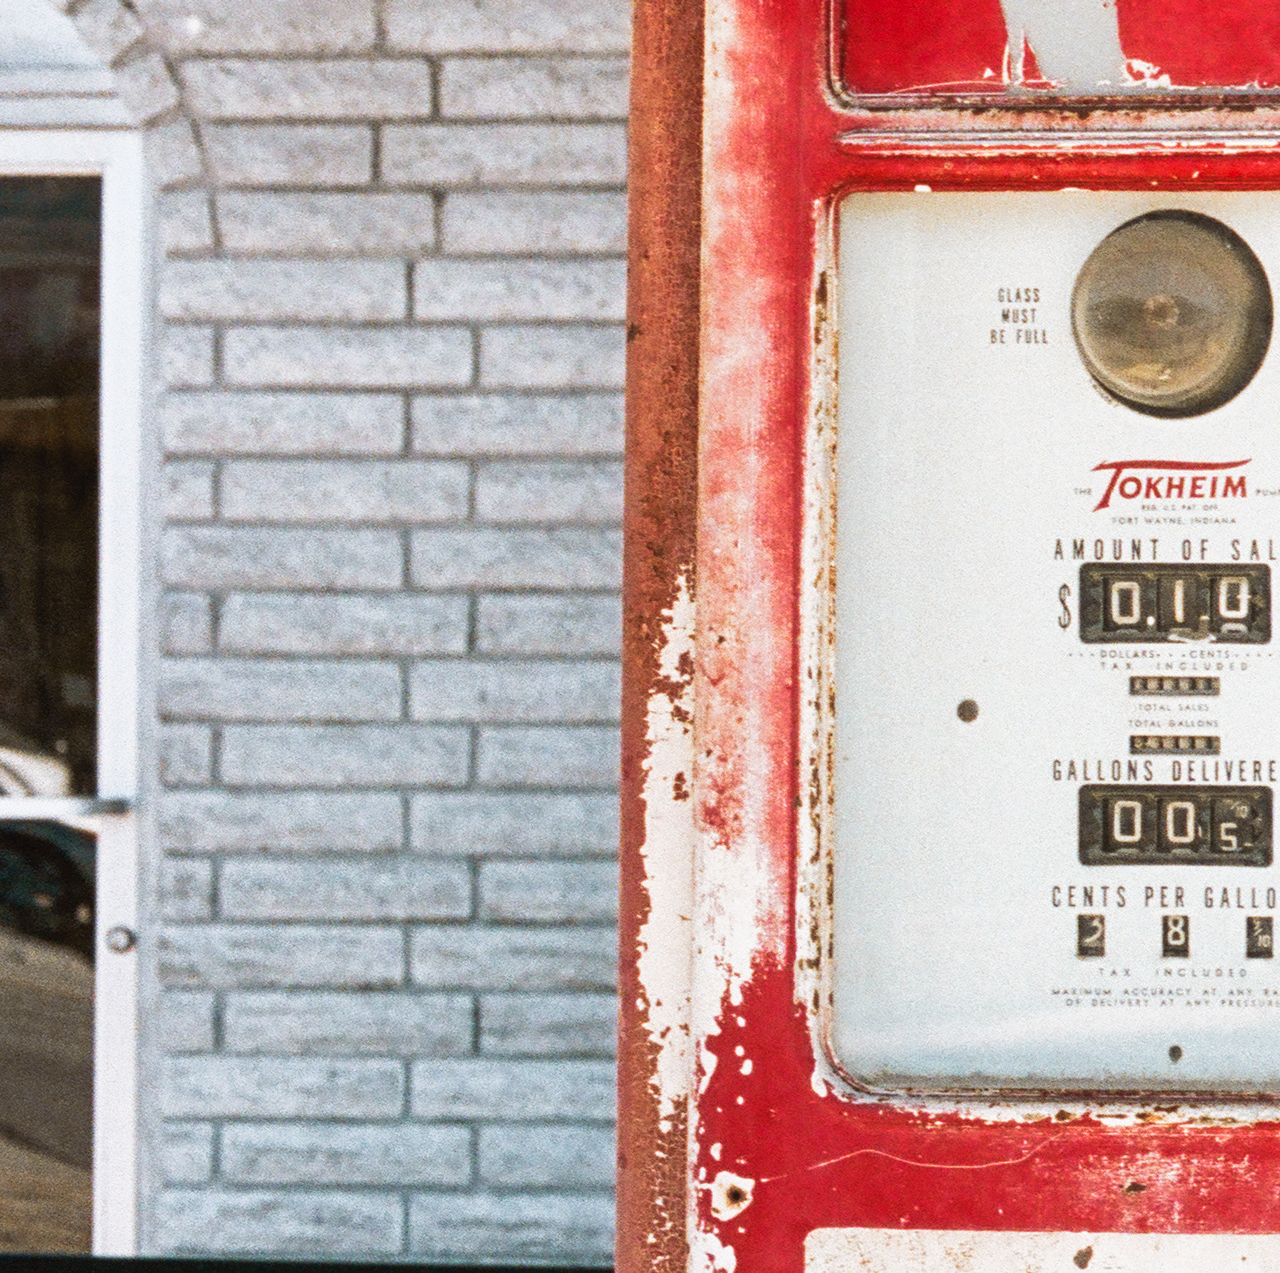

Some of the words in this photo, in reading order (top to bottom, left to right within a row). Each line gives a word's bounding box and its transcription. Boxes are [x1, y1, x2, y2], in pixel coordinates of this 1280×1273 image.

[998, 287, 1041, 303] GLASS
[1001, 308, 1037, 324] MUST
[990, 329, 1006, 344] BE
[1016, 328, 1048, 344] FULL
[1091, 458, 1253, 513] TOKHEIM
[1190, 516, 1237, 525] INDIANA
[1054, 538, 1159, 561] AMOUNT
[1181, 538, 1209, 561] OF
[1058, 583, 1073, 629] $
[1100, 661, 1133, 671] TAX
[1155, 661, 1249, 671] INCLUDED
[1138, 703, 1172, 712] TOTAL
[1179, 703, 1209, 712] SALES
[1129, 719, 1161, 728] TOTAL
[1168, 719, 1219, 728] GALLONS
[1053, 759, 1154, 782] GALLONS
[1051, 885, 1127, 909] CENTS
[1144, 885, 1185, 909] PER
[1167, 915, 1186, 946] 8
[1097, 968, 1131, 978] TAX
[1155, 968, 1248, 978] INCLUDED
[1052, 987, 1112, 996] MAXIMUM
[1123, 987, 1192, 997] ACCURACY
[1202, 987, 1217, 997] AT
[1228, 987, 1253, 997] ANY
[1066, 998, 1082, 1007] OF
[1091, 998, 1150, 1007] DELIVERY
[1160, 998, 1175, 1007] AT
[1185, 998, 1210, 1007] ANY
[1220, 998, 1280, 1008] PRESSURE
